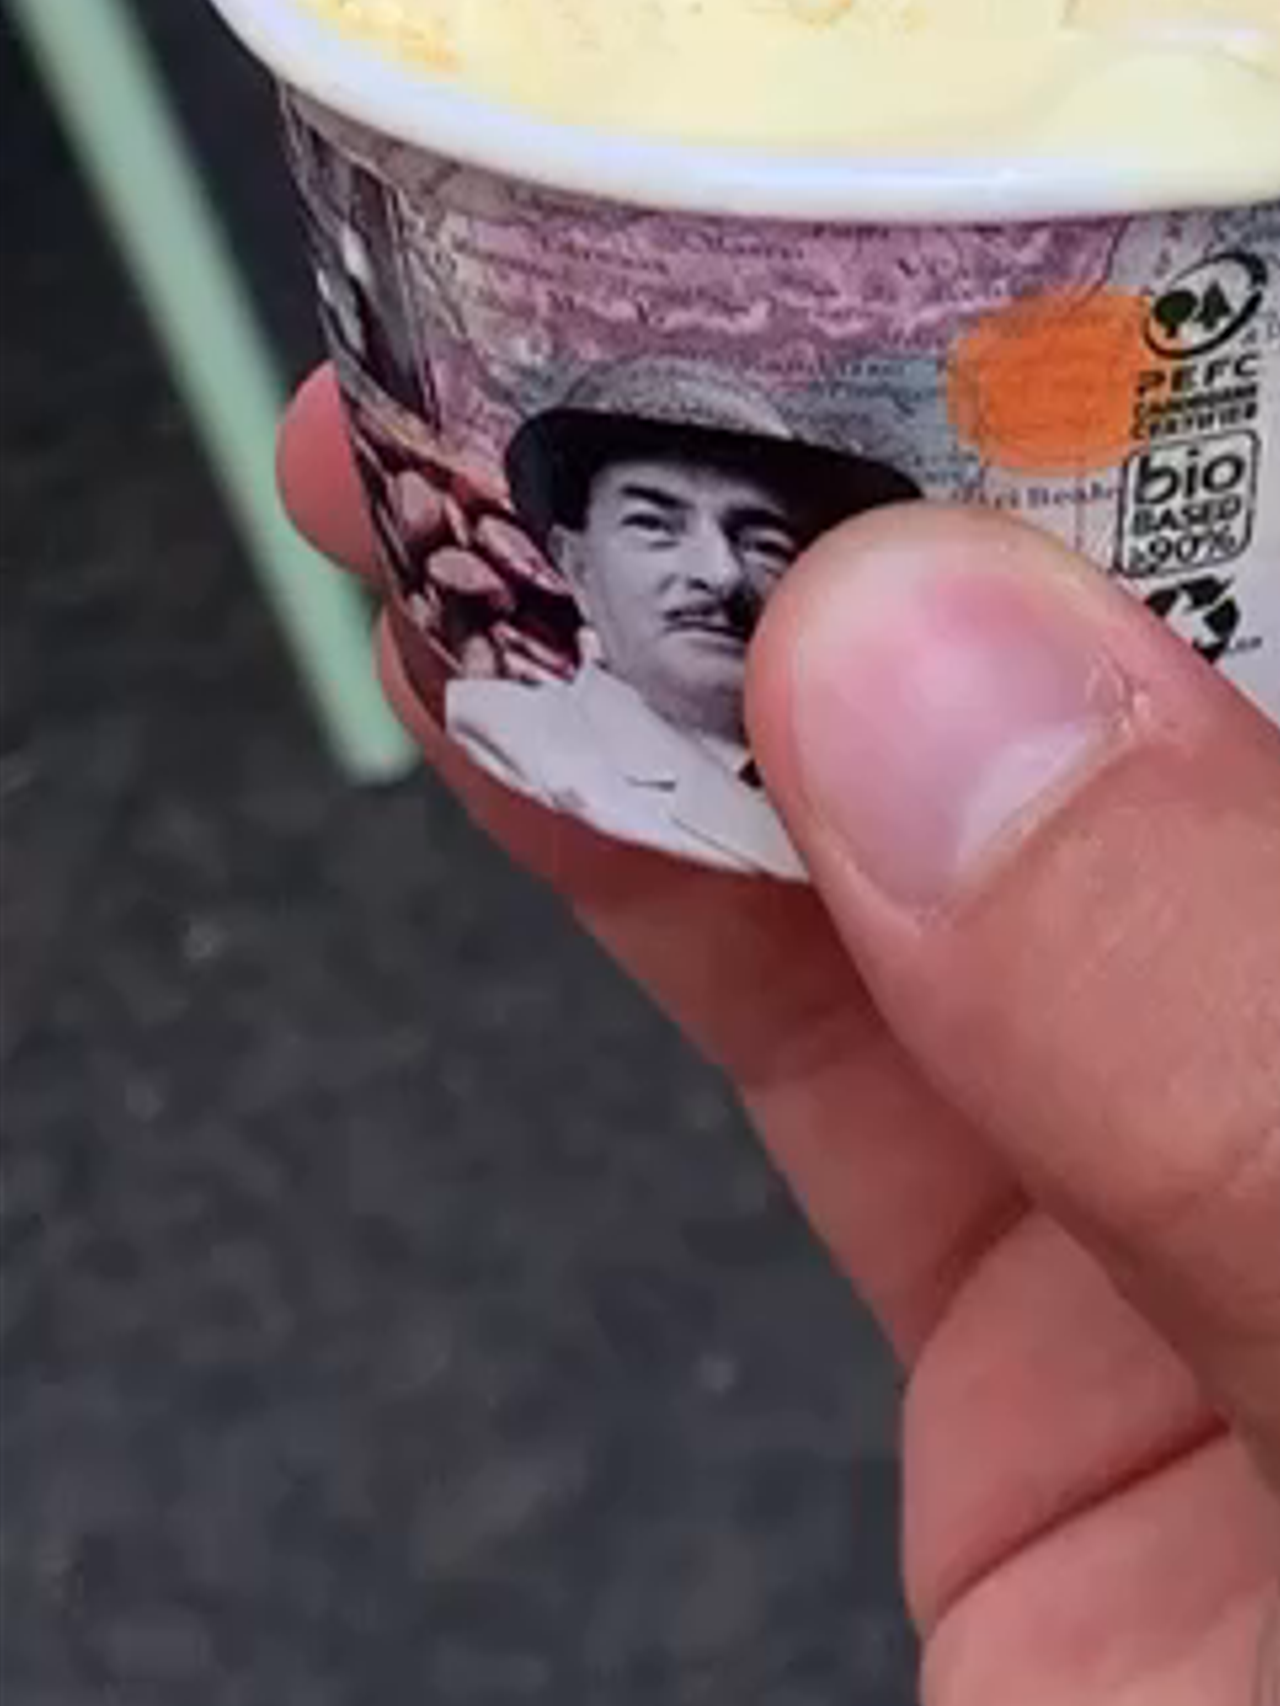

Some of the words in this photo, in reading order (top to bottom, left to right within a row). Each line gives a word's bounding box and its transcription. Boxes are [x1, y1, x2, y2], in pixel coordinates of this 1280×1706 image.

[1137, 352, 1258, 396] PEFC
[1135, 446, 1245, 505] bio
[1133, 494, 1241, 536] BASED
